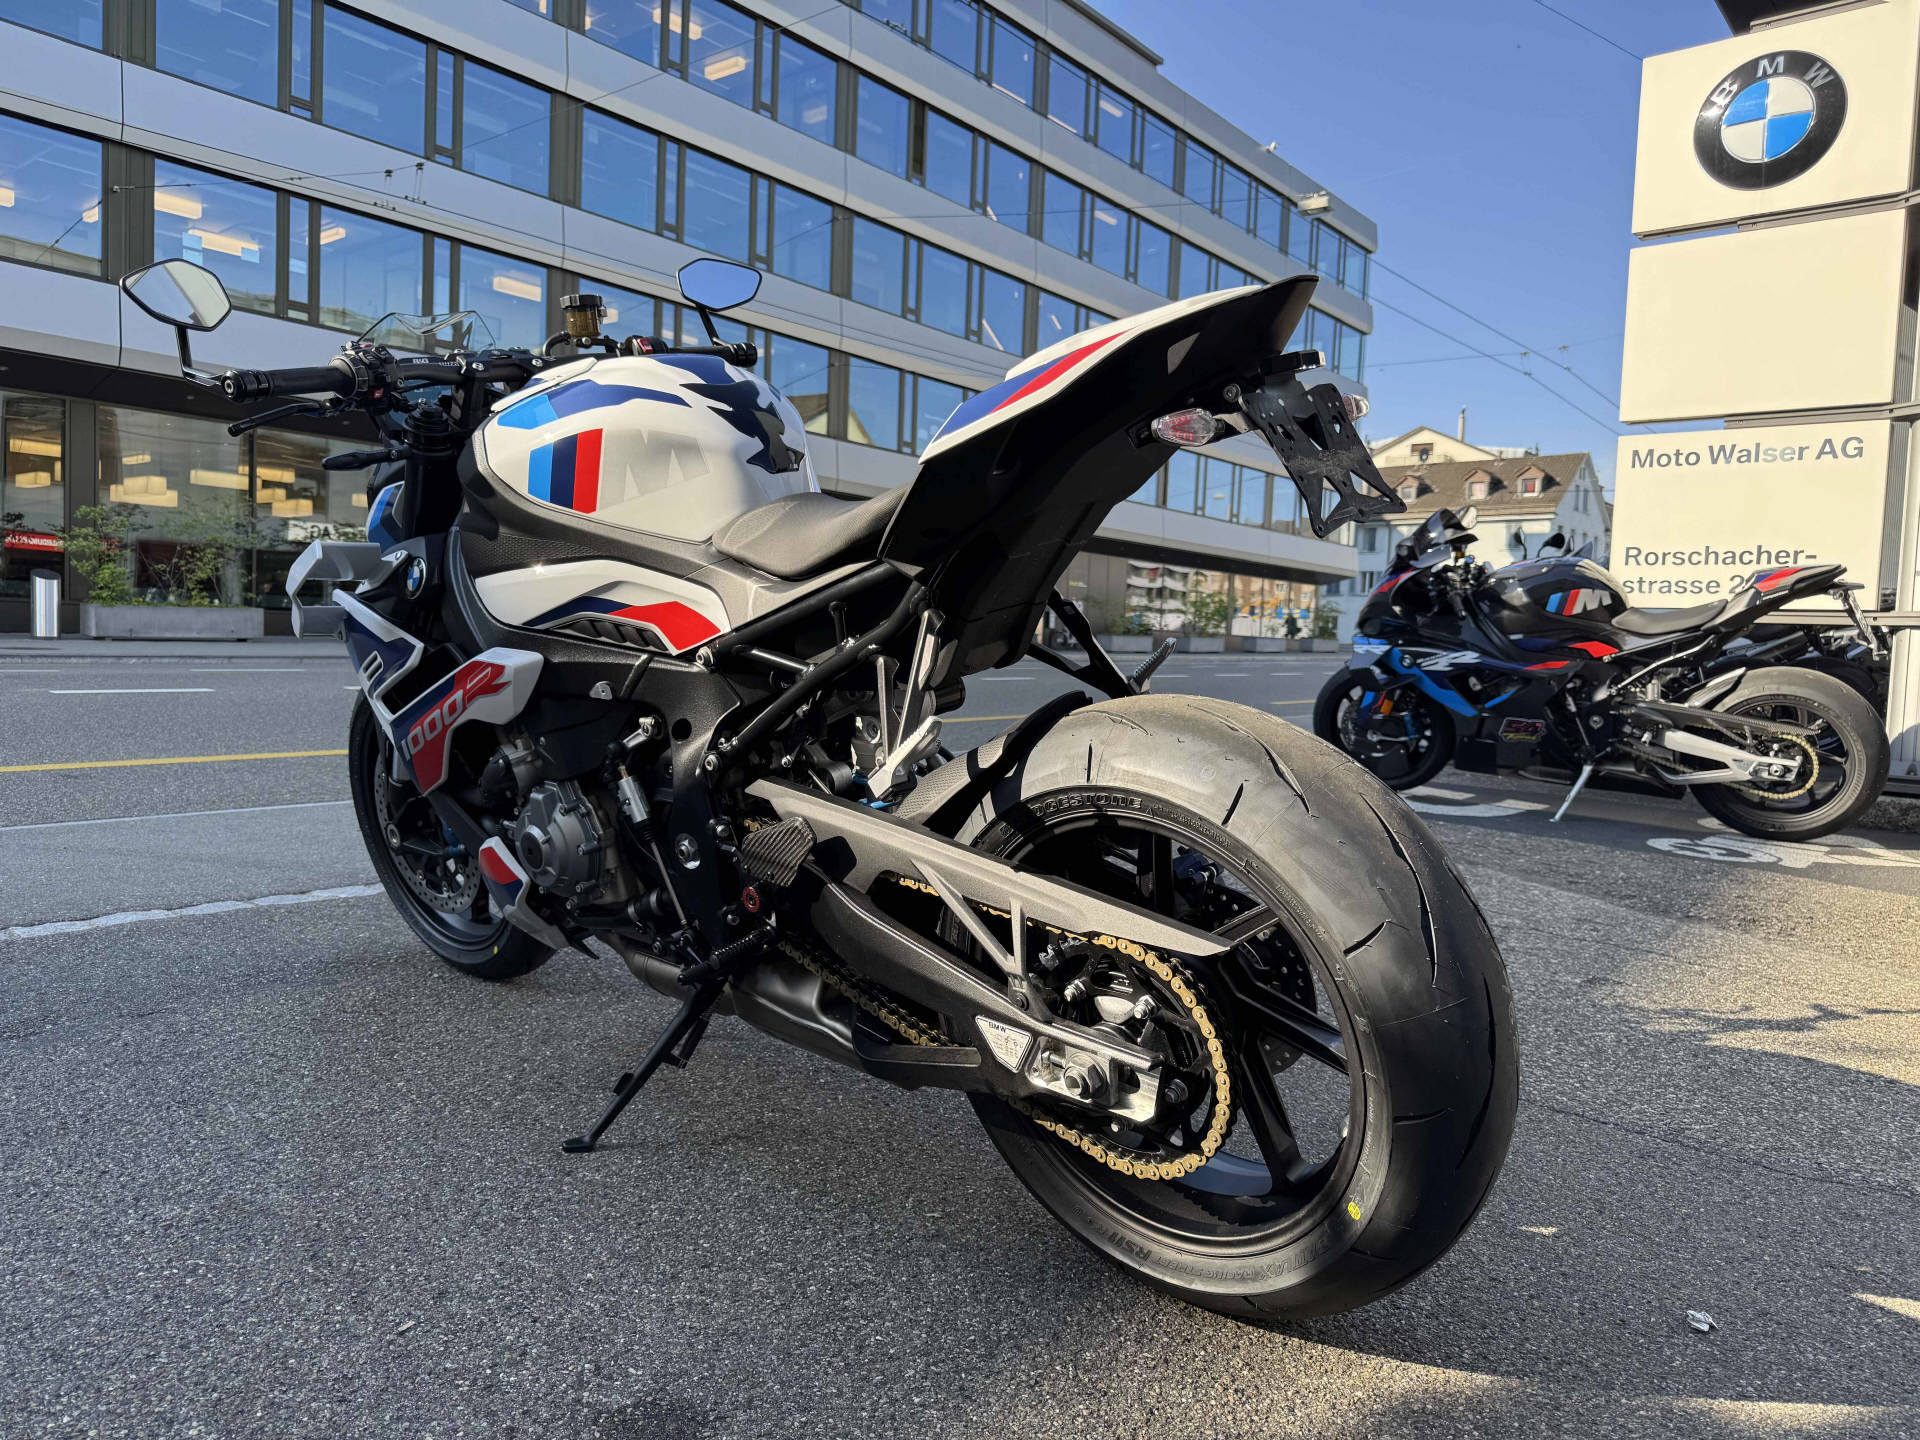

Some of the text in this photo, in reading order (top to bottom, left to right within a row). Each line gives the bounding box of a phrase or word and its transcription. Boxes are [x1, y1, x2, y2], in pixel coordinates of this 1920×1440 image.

[1710, 55, 1834, 107] BMW
[1631, 436, 1864, 468] Moto Walser AG
[1624, 545, 1817, 566] Rorschacher-
[1622, 576, 1720, 595] strasse
